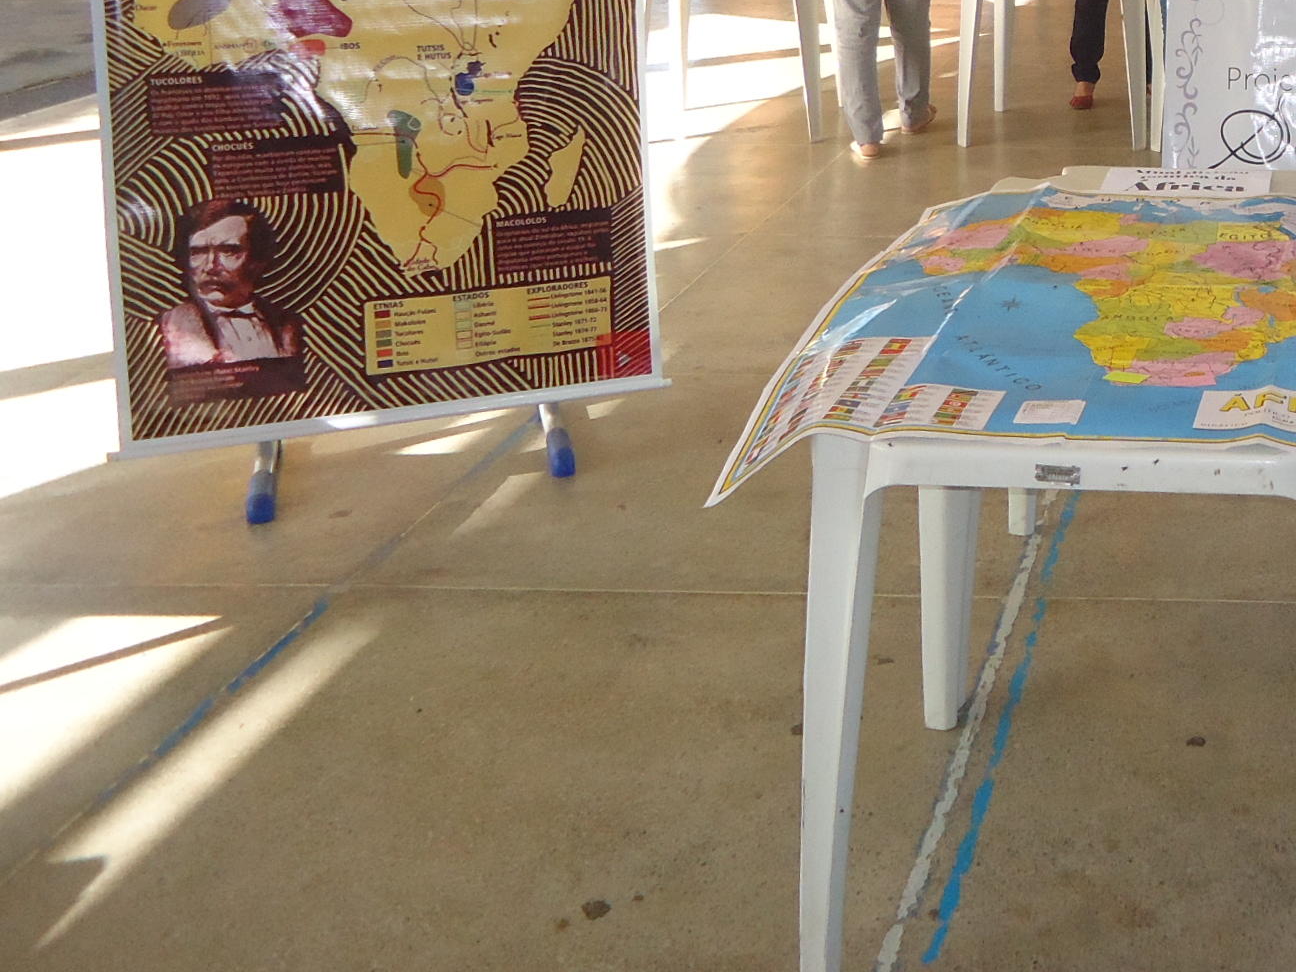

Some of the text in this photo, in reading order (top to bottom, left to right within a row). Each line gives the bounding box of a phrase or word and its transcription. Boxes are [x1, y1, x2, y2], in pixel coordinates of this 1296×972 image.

[340, 41, 361, 50] IBOS
[416, 44, 445, 53] TUTSIS
[425, 52, 452, 60] HUTUS
[150, 75, 203, 86] TUCOLORES
[495, 217, 547, 228] MACOLOLOS
[1219, 231, 1272, 241] EGITO
[526, 281, 589, 295] EXPLORADORES
[452, 291, 490, 302] ESTADOS
[373, 300, 404, 311] ETNIAS
